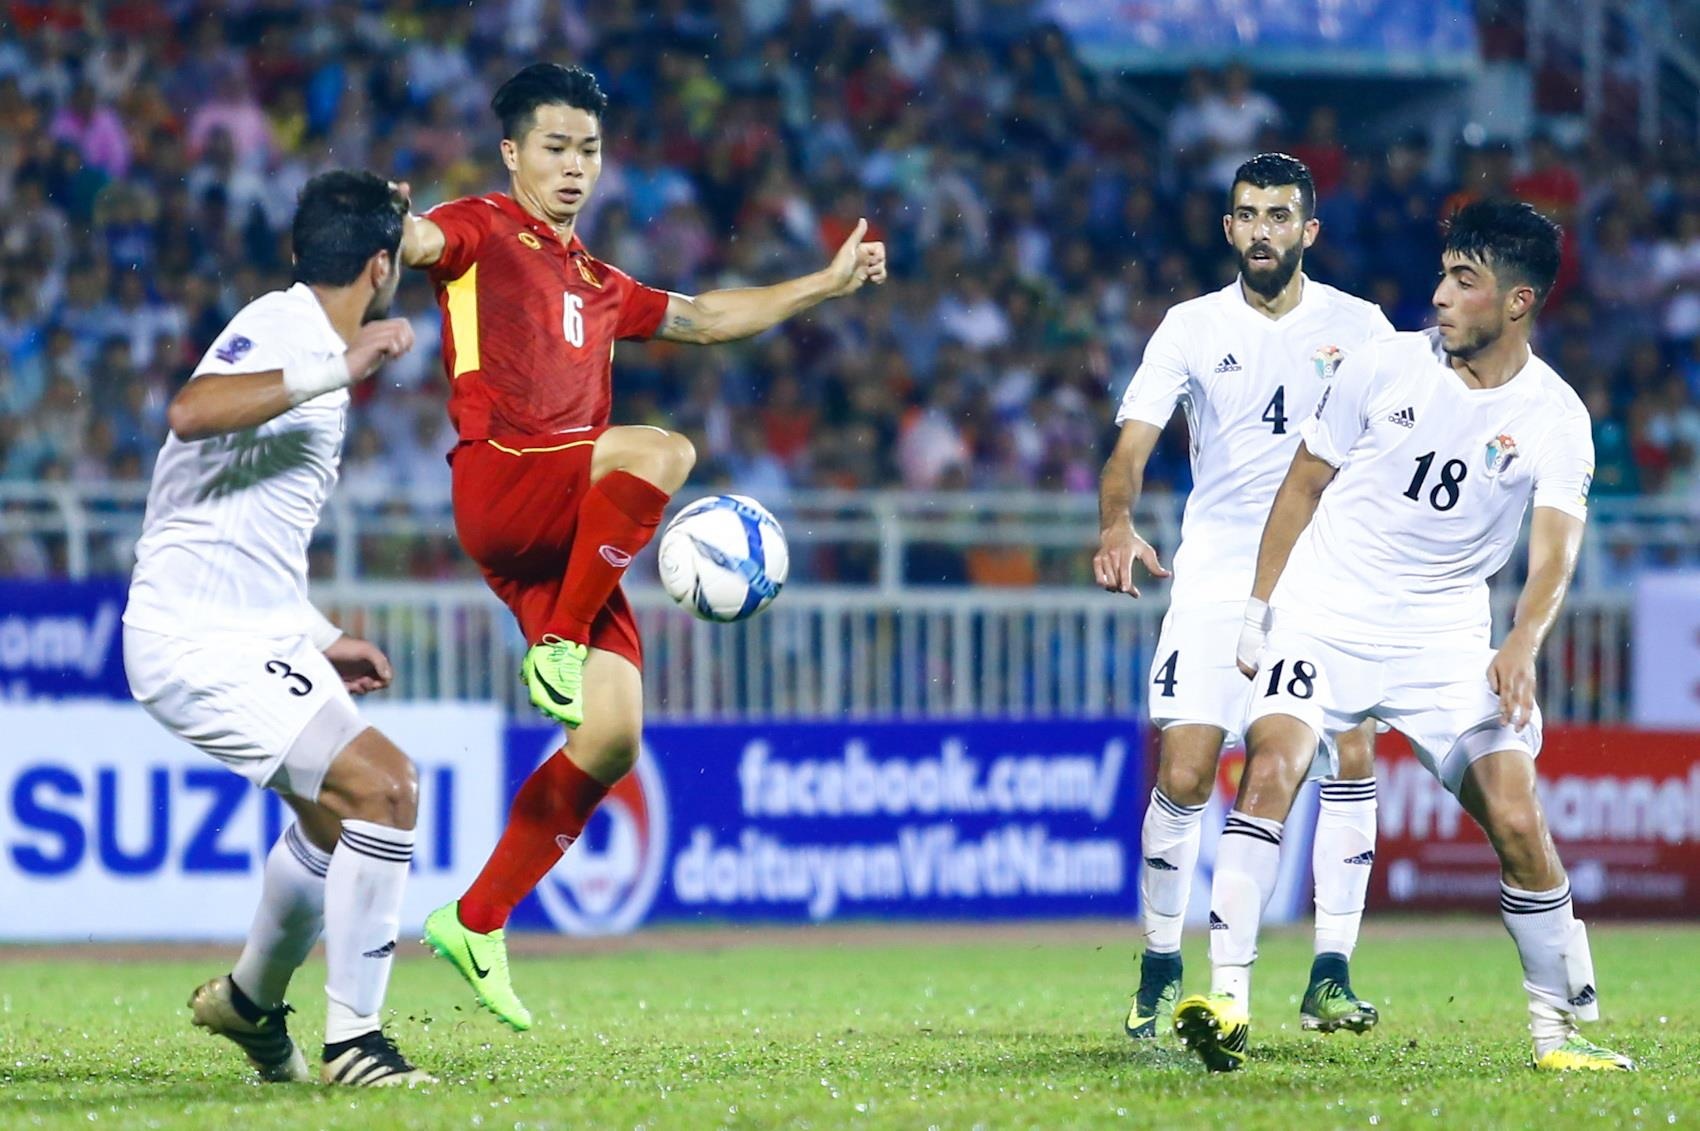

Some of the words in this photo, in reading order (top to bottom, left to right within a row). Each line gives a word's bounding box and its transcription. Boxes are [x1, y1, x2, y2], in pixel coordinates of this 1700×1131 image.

[563, 291, 583, 348] 16
[1214, 365, 1242, 374] adidas
[1262, 385, 1288, 434] 4
[1388, 415, 1414, 429] adida
[1403, 451, 1467, 511] 18
[265, 660, 312, 696] 3
[1154, 650, 1179, 697] 4
[1264, 659, 1317, 699] 18
[740, 739, 1126, 820] facebook.com/
[9, 765, 454, 877] SUZI
[673, 823, 1125, 918] doituyenVietNam
